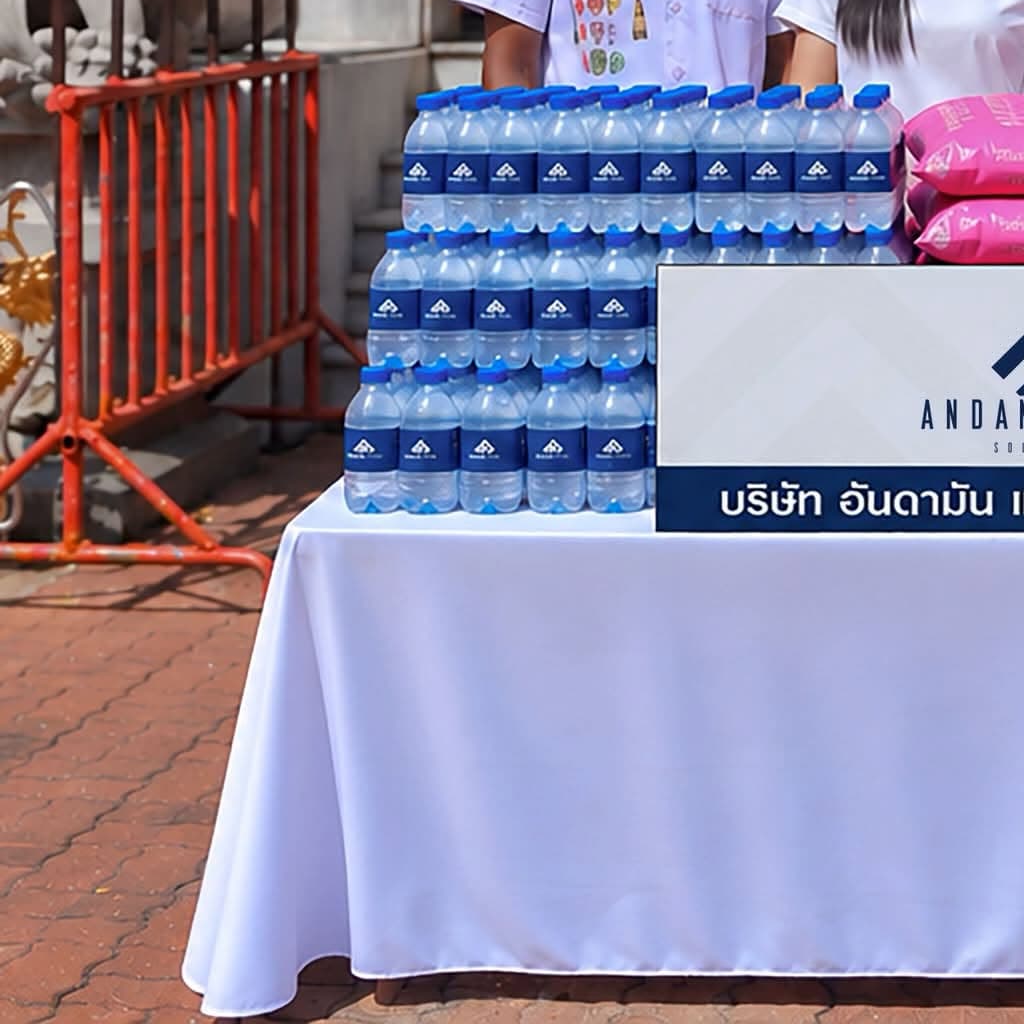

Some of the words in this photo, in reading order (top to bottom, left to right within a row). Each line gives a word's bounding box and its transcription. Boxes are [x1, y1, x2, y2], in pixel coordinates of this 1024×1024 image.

[720, 480, 823, 517] บริษัท
[838, 480, 994, 517] อันดามัน
